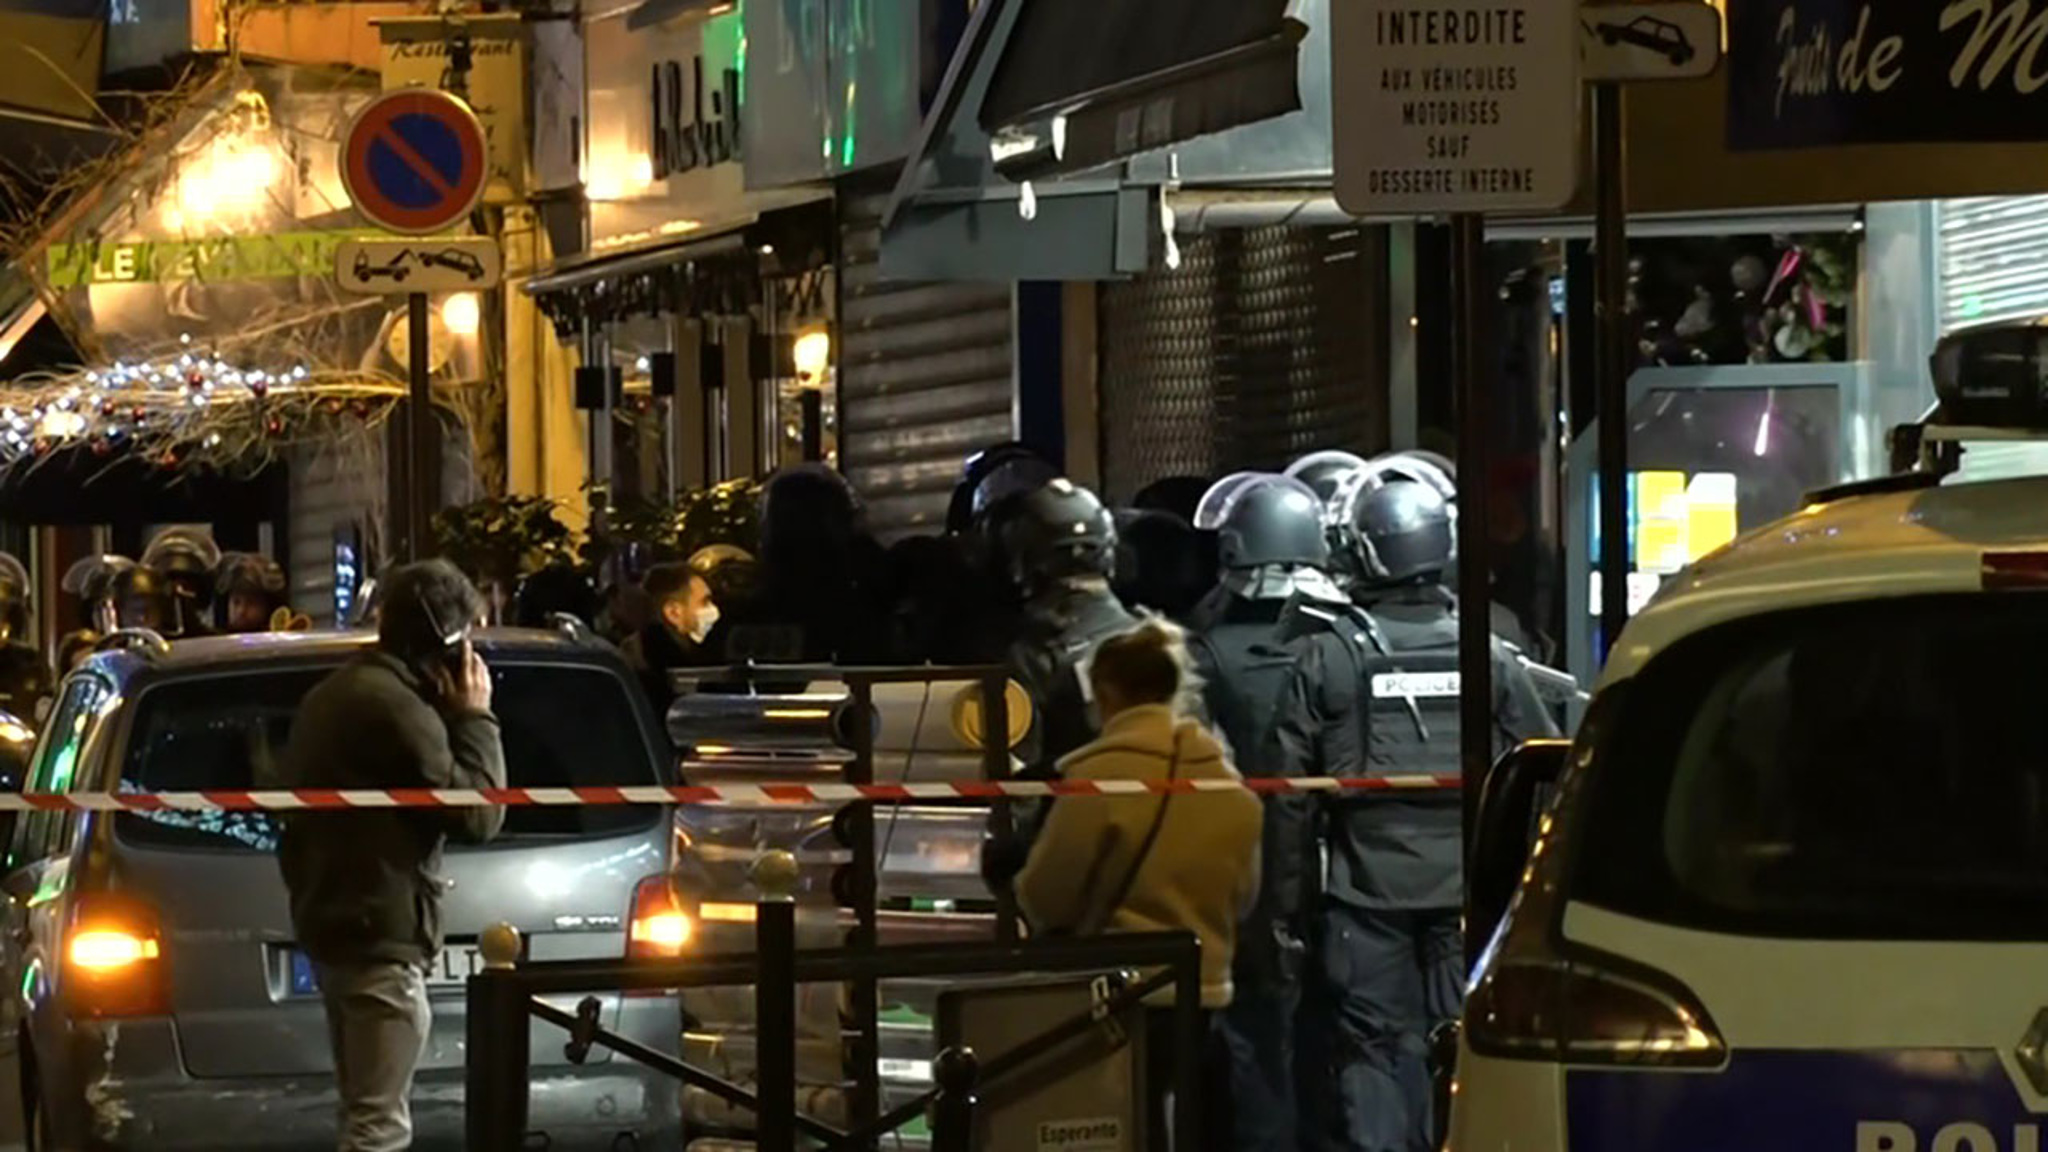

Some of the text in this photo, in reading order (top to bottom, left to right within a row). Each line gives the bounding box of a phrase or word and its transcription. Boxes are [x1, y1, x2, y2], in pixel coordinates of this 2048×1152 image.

[1376, 9, 1526, 45] INTERDITE
[391, 38, 513, 61] Restrant
[1837, 4, 1902, 93] de
[1381, 62, 1517, 91] AUX VÉHICULES
[1402, 97, 1500, 125] MOTORISÉS
[1426, 134, 1470, 159] SAUF
[1368, 167, 1533, 194] DESSERTE INTERNE
[93, 247, 135, 281] LE
